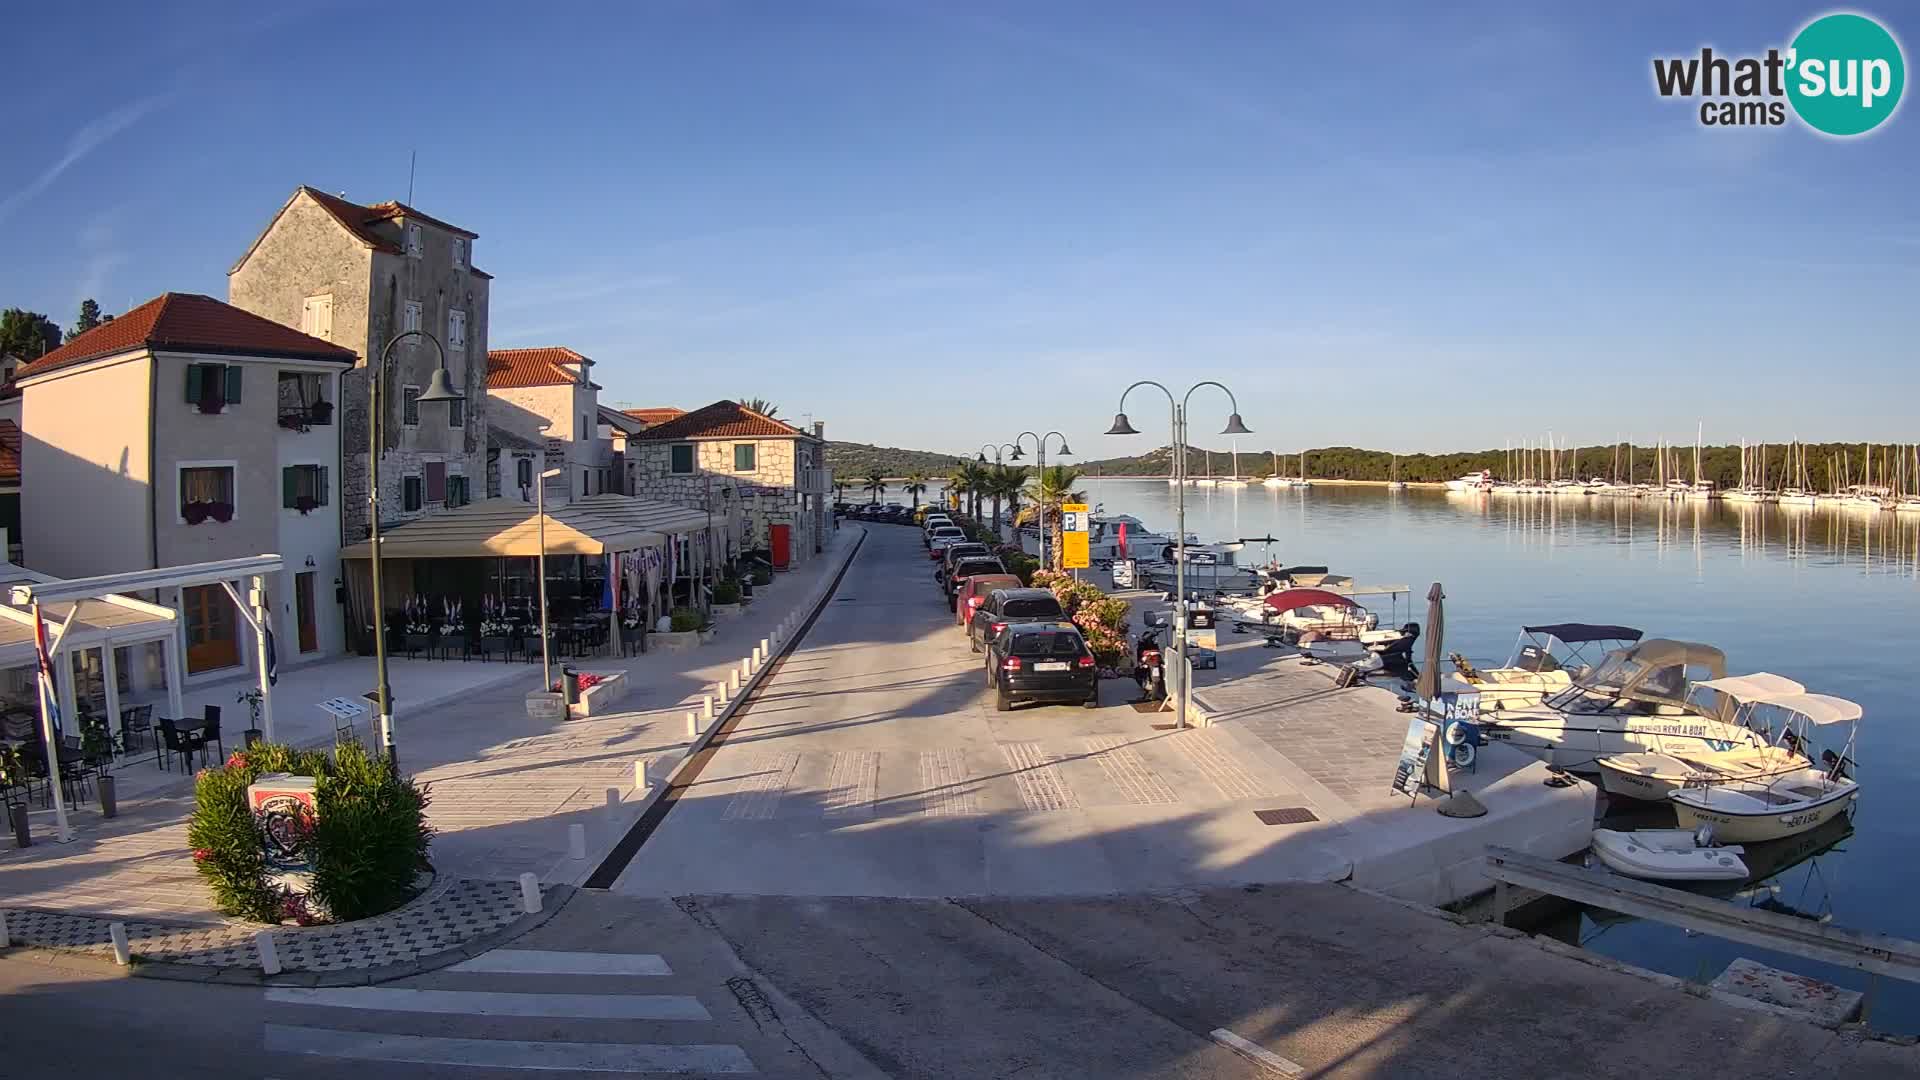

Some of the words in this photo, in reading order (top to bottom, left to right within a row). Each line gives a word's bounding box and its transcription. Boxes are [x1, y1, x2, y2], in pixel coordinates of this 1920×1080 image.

[1065, 513, 1076, 530] P
[1446, 710, 1454, 720] A
[1663, 725, 1682, 734] RENT
[1682, 725, 1688, 734] A
[1689, 725, 1707, 736] BOAT
